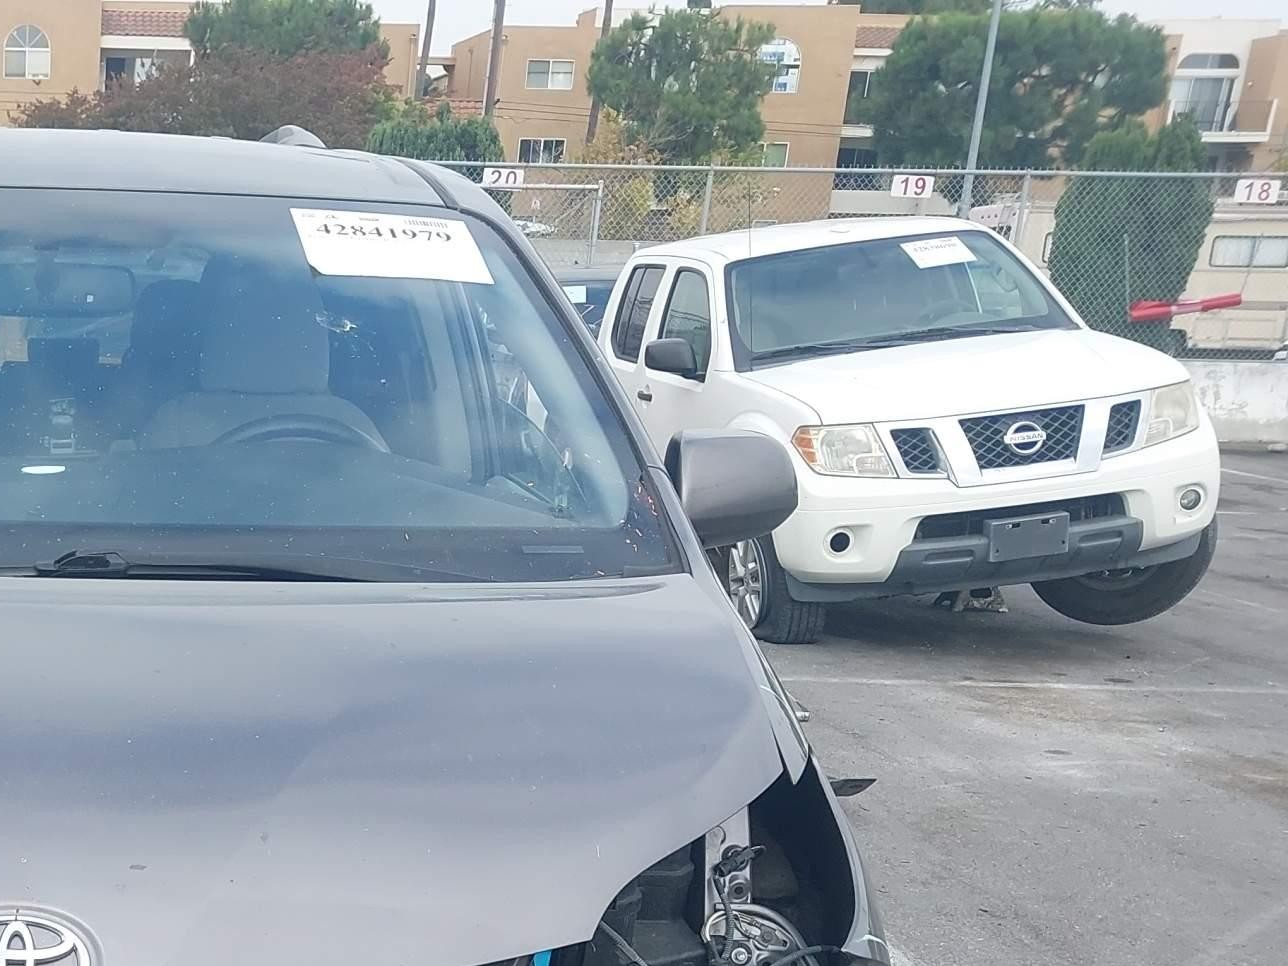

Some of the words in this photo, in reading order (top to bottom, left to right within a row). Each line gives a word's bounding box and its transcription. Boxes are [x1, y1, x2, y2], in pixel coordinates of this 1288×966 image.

[490, 169, 517, 185] 20
[900, 176, 927, 196] 19
[1244, 182, 1272, 202] 18
[315, 223, 452, 242] 42841979
[1009, 432, 1044, 442] NISSAN
